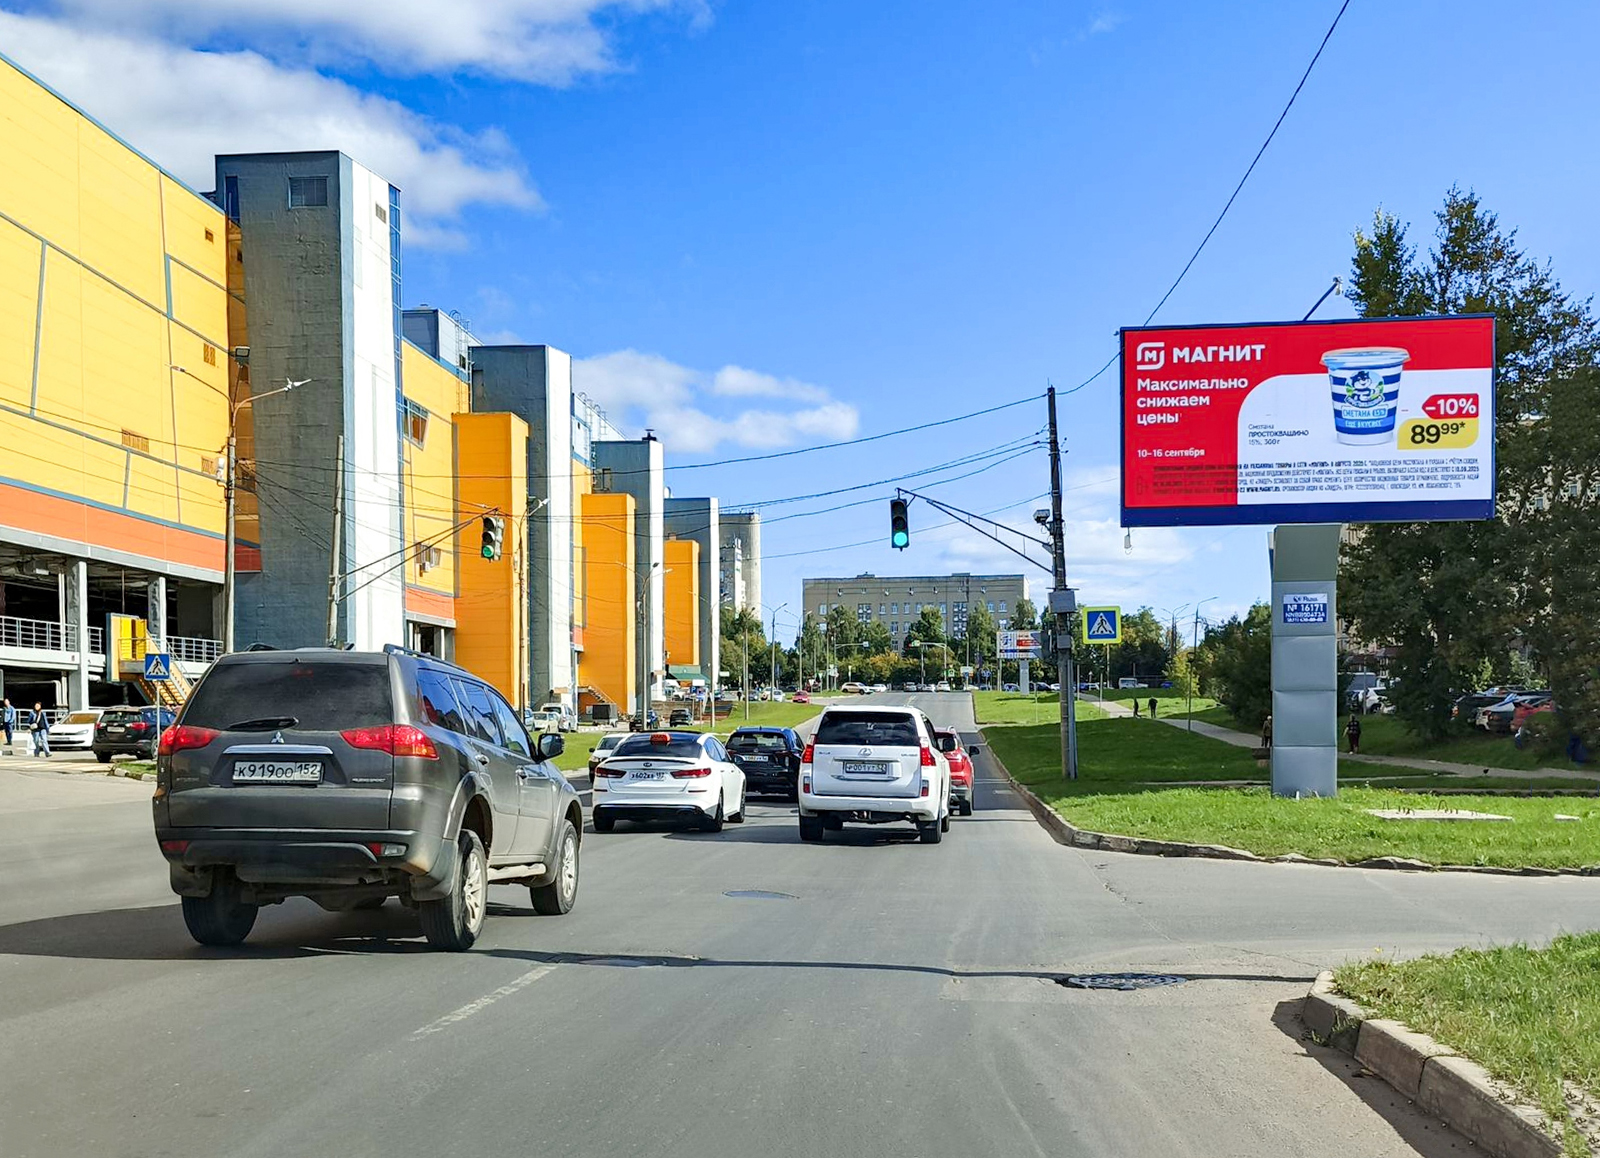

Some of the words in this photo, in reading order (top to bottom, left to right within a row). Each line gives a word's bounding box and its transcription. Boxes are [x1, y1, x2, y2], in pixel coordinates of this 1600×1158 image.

[1173, 344, 1265, 363] МАГНИТ
[1137, 378, 1248, 391] Максимально
[1137, 396, 1210, 408] снижаем
[1165, 447, 1205, 458] сентября
[1301, 603, 1323, 612] 16171
